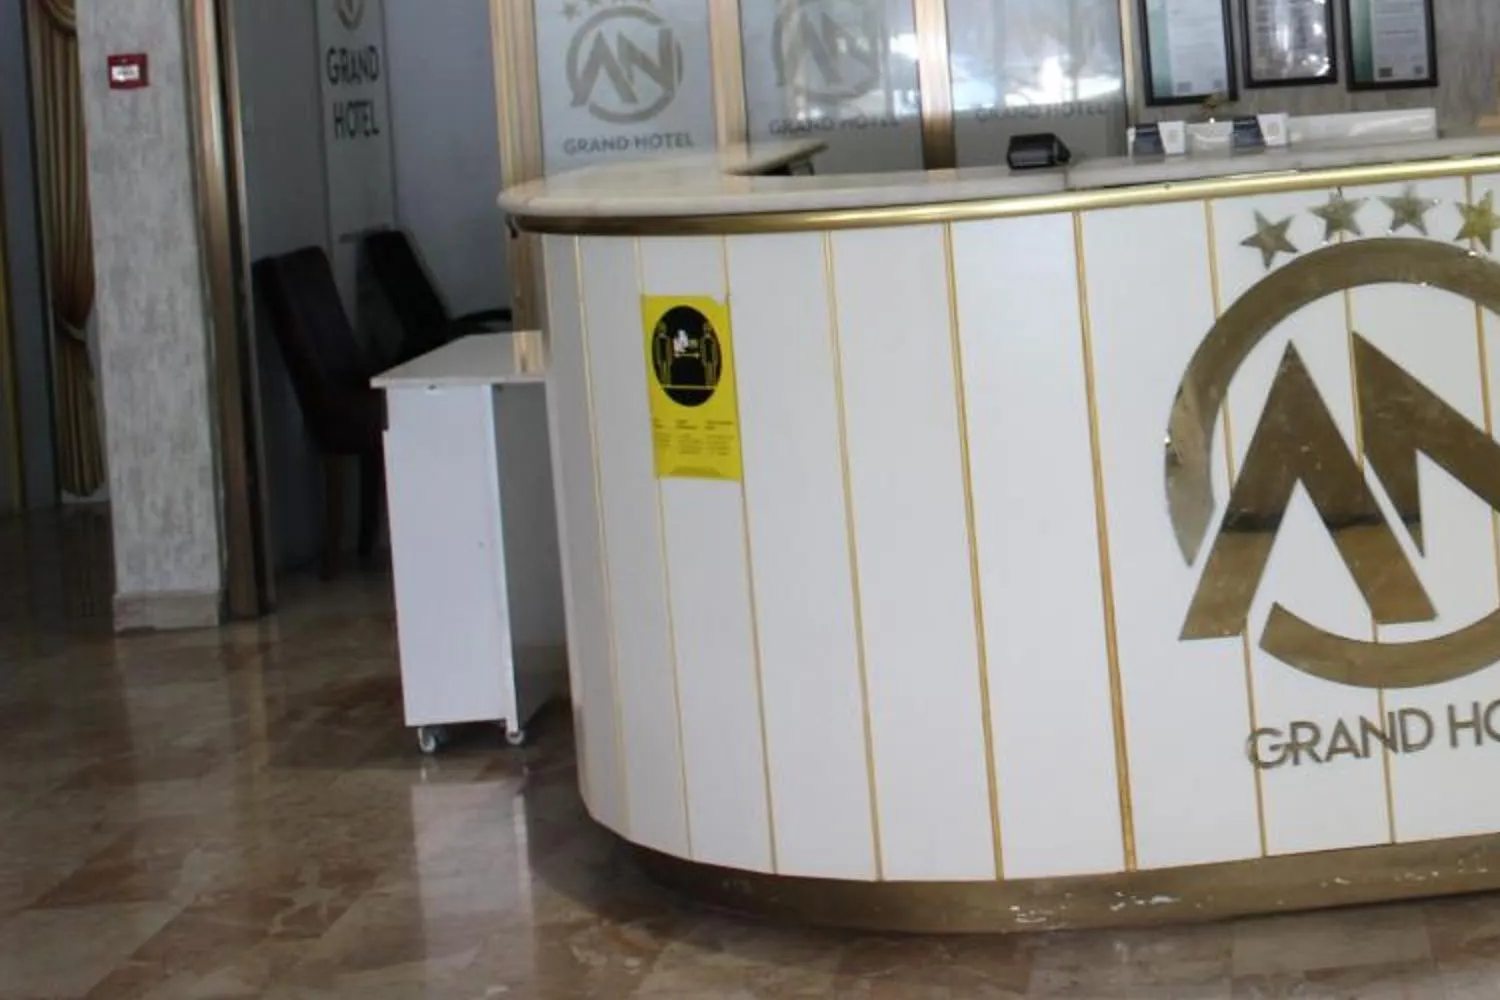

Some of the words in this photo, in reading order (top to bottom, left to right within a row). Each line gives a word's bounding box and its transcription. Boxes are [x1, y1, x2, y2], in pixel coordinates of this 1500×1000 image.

[326, 44, 380, 86] GRAND
[332, 100, 380, 140] HOTEL
[563, 136, 630, 155] GRAND
[634, 131, 695, 150] HOTEL
[1245, 707, 1434, 770] GRAND
